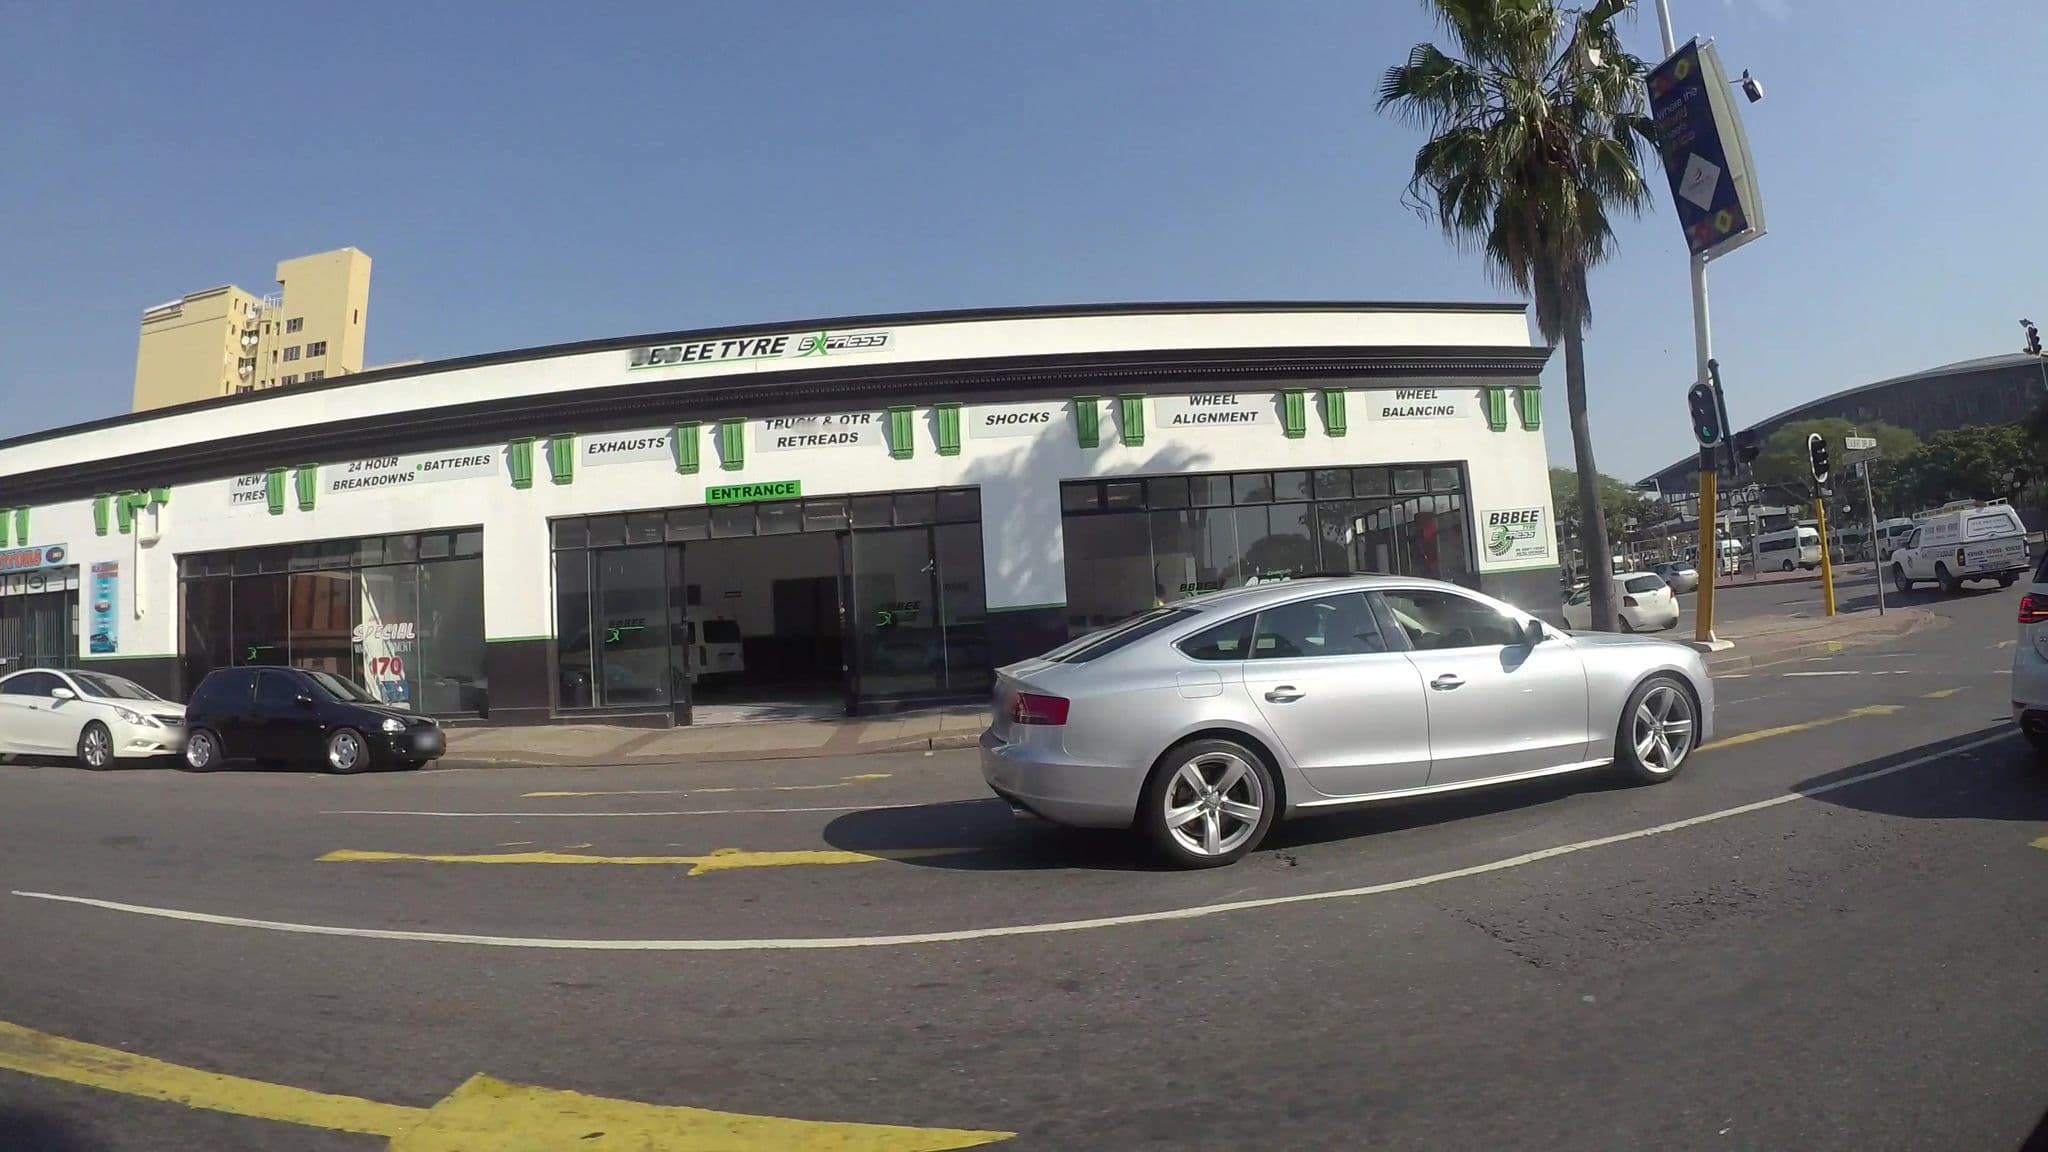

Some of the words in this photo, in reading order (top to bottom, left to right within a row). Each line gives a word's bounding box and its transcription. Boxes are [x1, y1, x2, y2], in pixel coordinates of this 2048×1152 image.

[720, 336, 790, 358] TYRE
[796, 331, 888, 357] EXPRESS
[1189, 393, 1239, 407] WHEEL
[1395, 388, 1438, 400] WHEEL
[985, 411, 1050, 426] SHOCKS
[1172, 411, 1259, 425] ALIGNMENT
[1382, 405, 1455, 418] BALANCING
[588, 437, 665, 455] EXHAUSTS
[776, 432, 859, 448] RETREADS
[347, 463, 362, 473] 24
[365, 456, 399, 471] HOUR
[423, 454, 491, 472] BATTERIES
[237, 474, 262, 487] NEW
[332, 471, 415, 491] BREAKDOWNS
[232, 489, 266, 503] TYRES
[711, 482, 796, 501] ENTRANCE
[1489, 510, 1540, 525] BBBEE
[352, 622, 416, 642] SPECIAL
